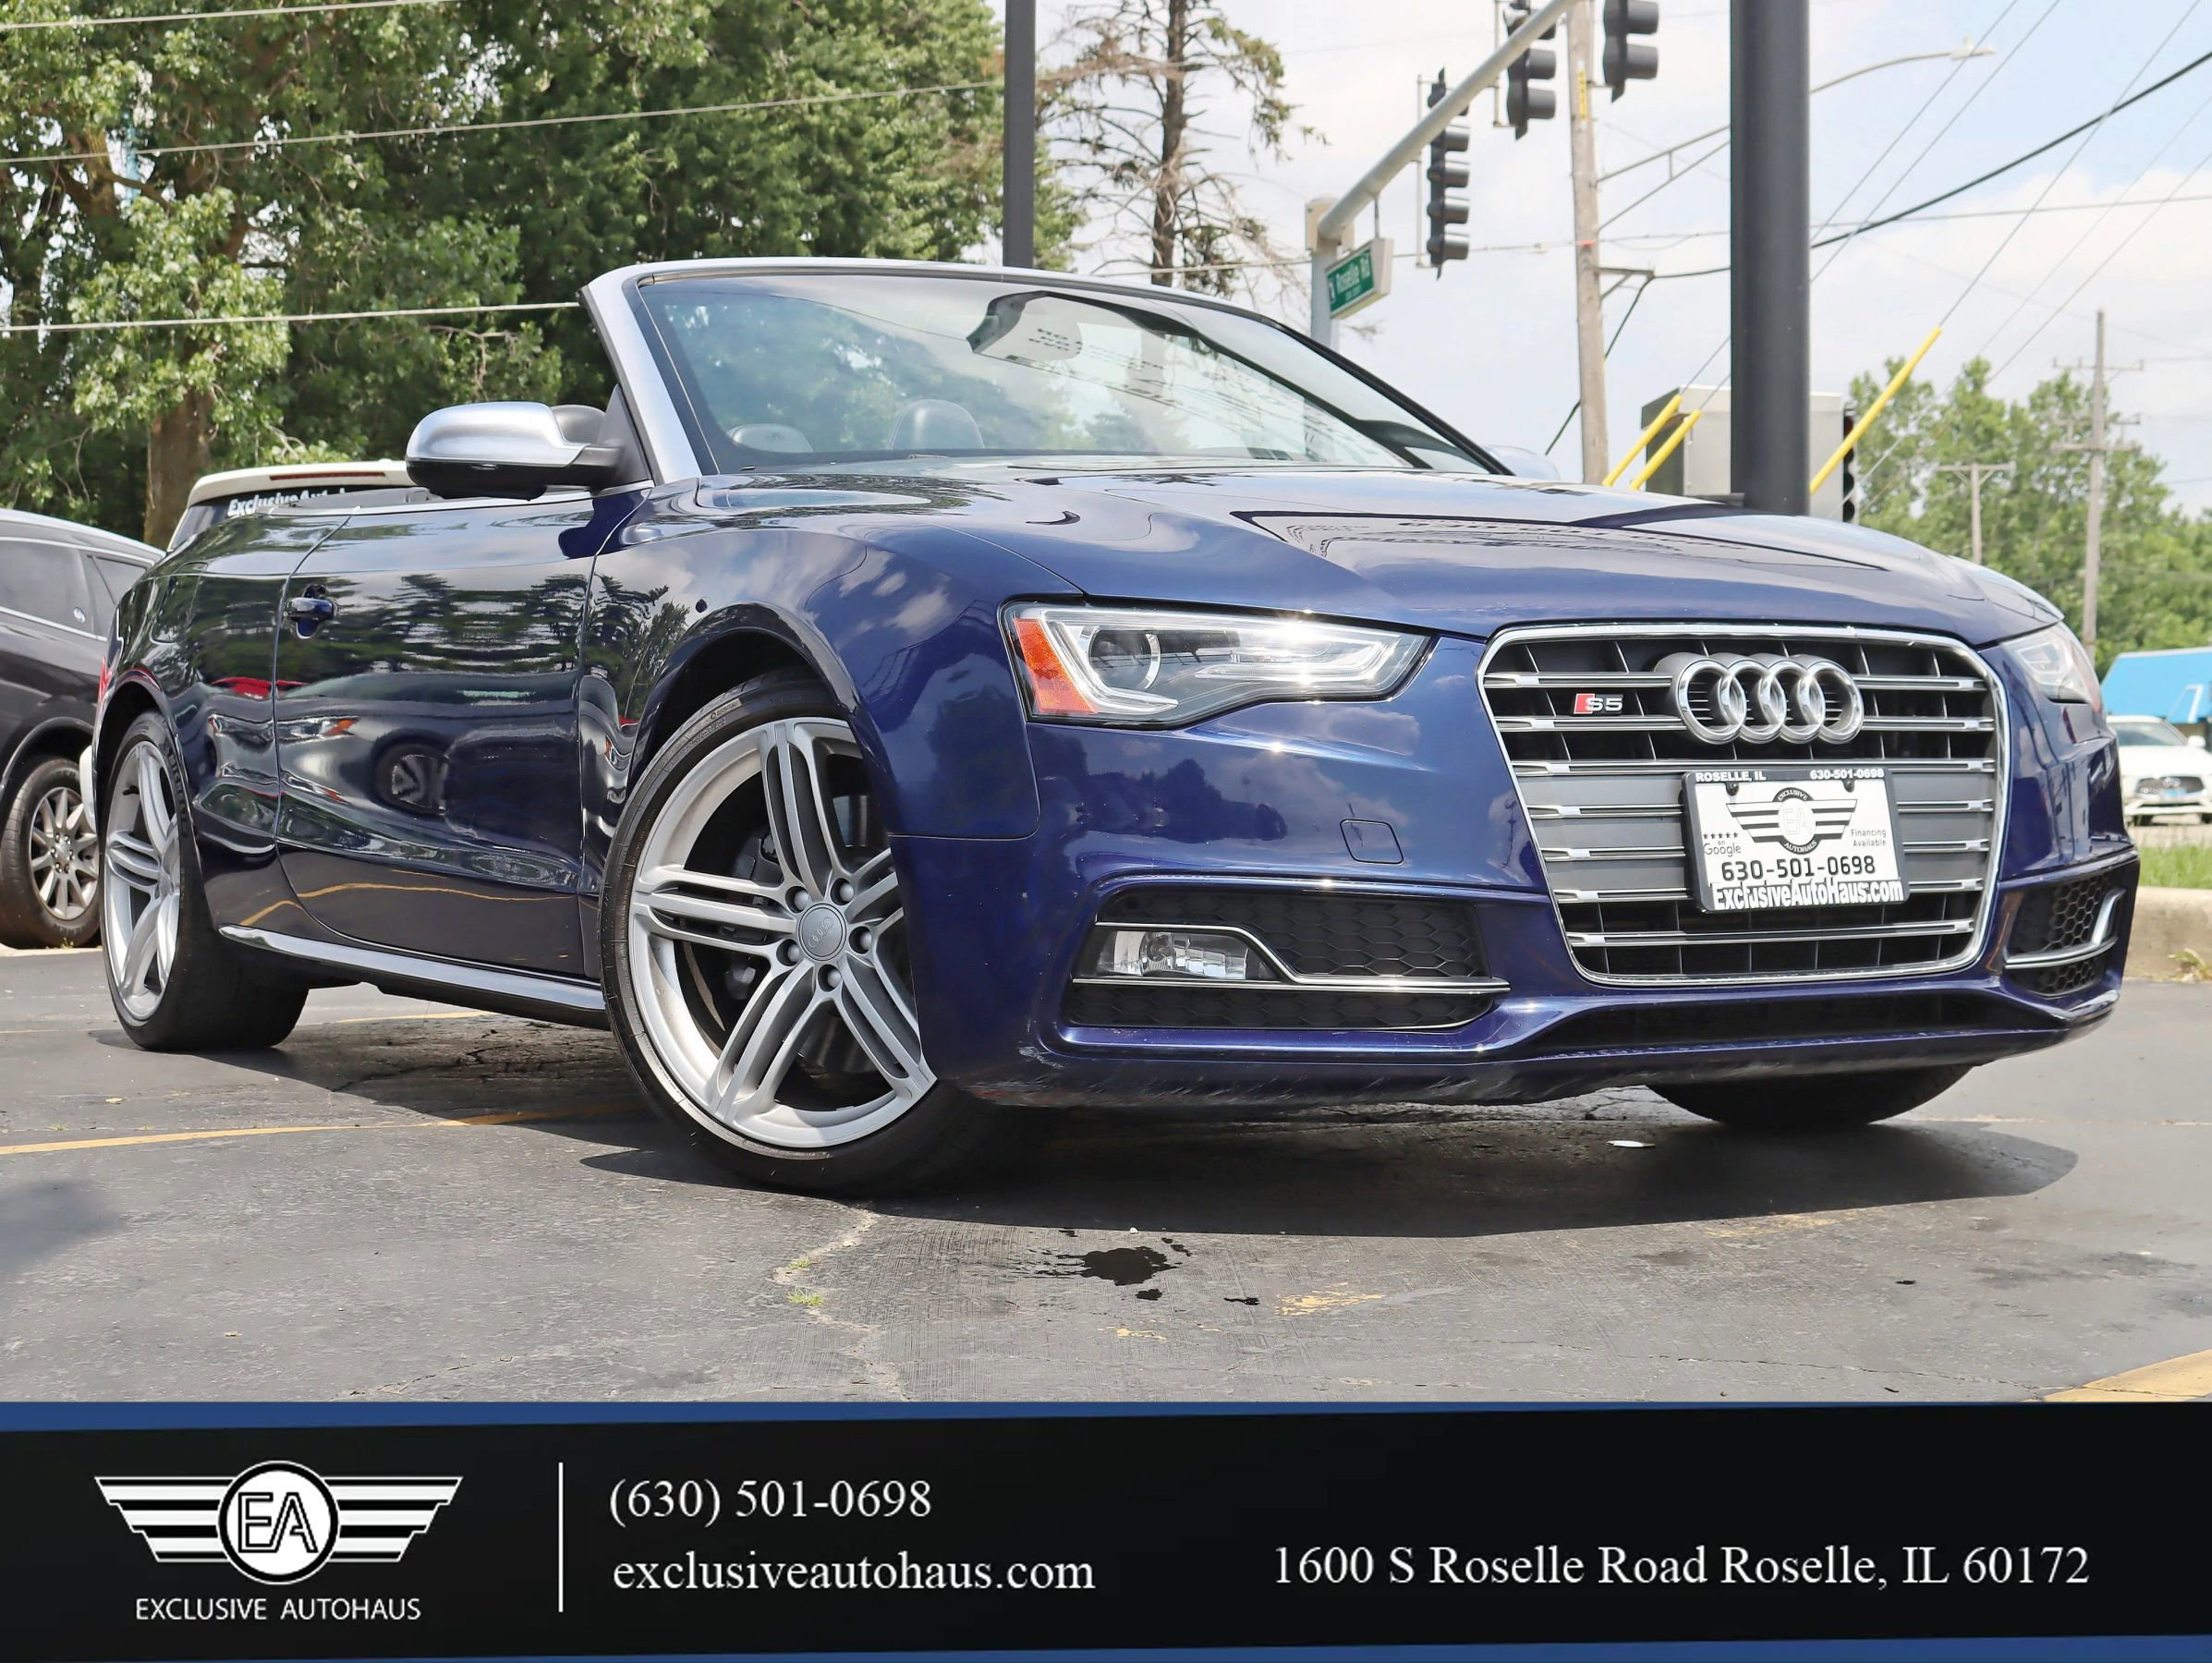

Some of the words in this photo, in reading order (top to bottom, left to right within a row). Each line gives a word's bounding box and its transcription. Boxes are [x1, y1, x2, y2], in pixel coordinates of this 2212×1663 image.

[1585, 697, 1623, 712] S5
[1695, 771, 1753, 783] ROSELLE,
[1755, 769, 1767, 782] IL
[1809, 768, 1885, 780] 630-501-0698
[1777, 789, 1809, 802] EXCLUSIVE
[1851, 829, 1887, 838] Financing
[1783, 839, 1818, 854] AUTOHAUS
[1853, 838, 1887, 847] Available
[1703, 843, 1742, 857] Google
[1721, 855, 1876, 881] 630-501-0698
